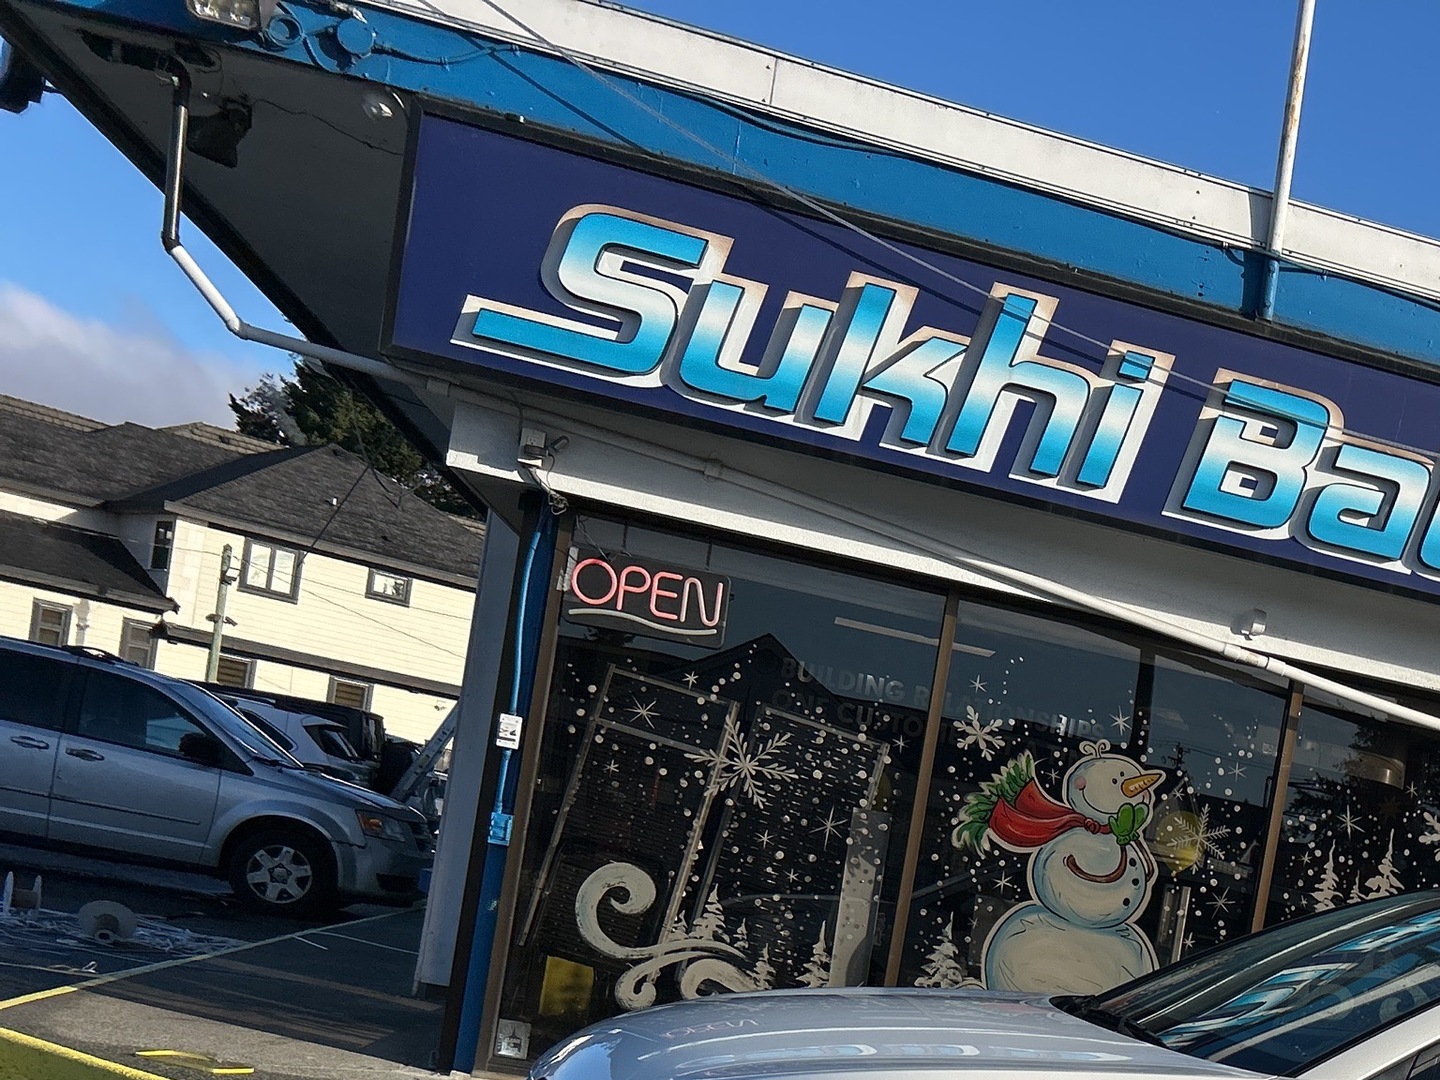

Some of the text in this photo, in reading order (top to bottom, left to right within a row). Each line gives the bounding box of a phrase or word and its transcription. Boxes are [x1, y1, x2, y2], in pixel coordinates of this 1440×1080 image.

[450, 203, 1177, 504] Sukhi
[570, 557, 725, 628] OPEN
[780, 658, 1104, 741] BUILDING RLATIONSHIPS
